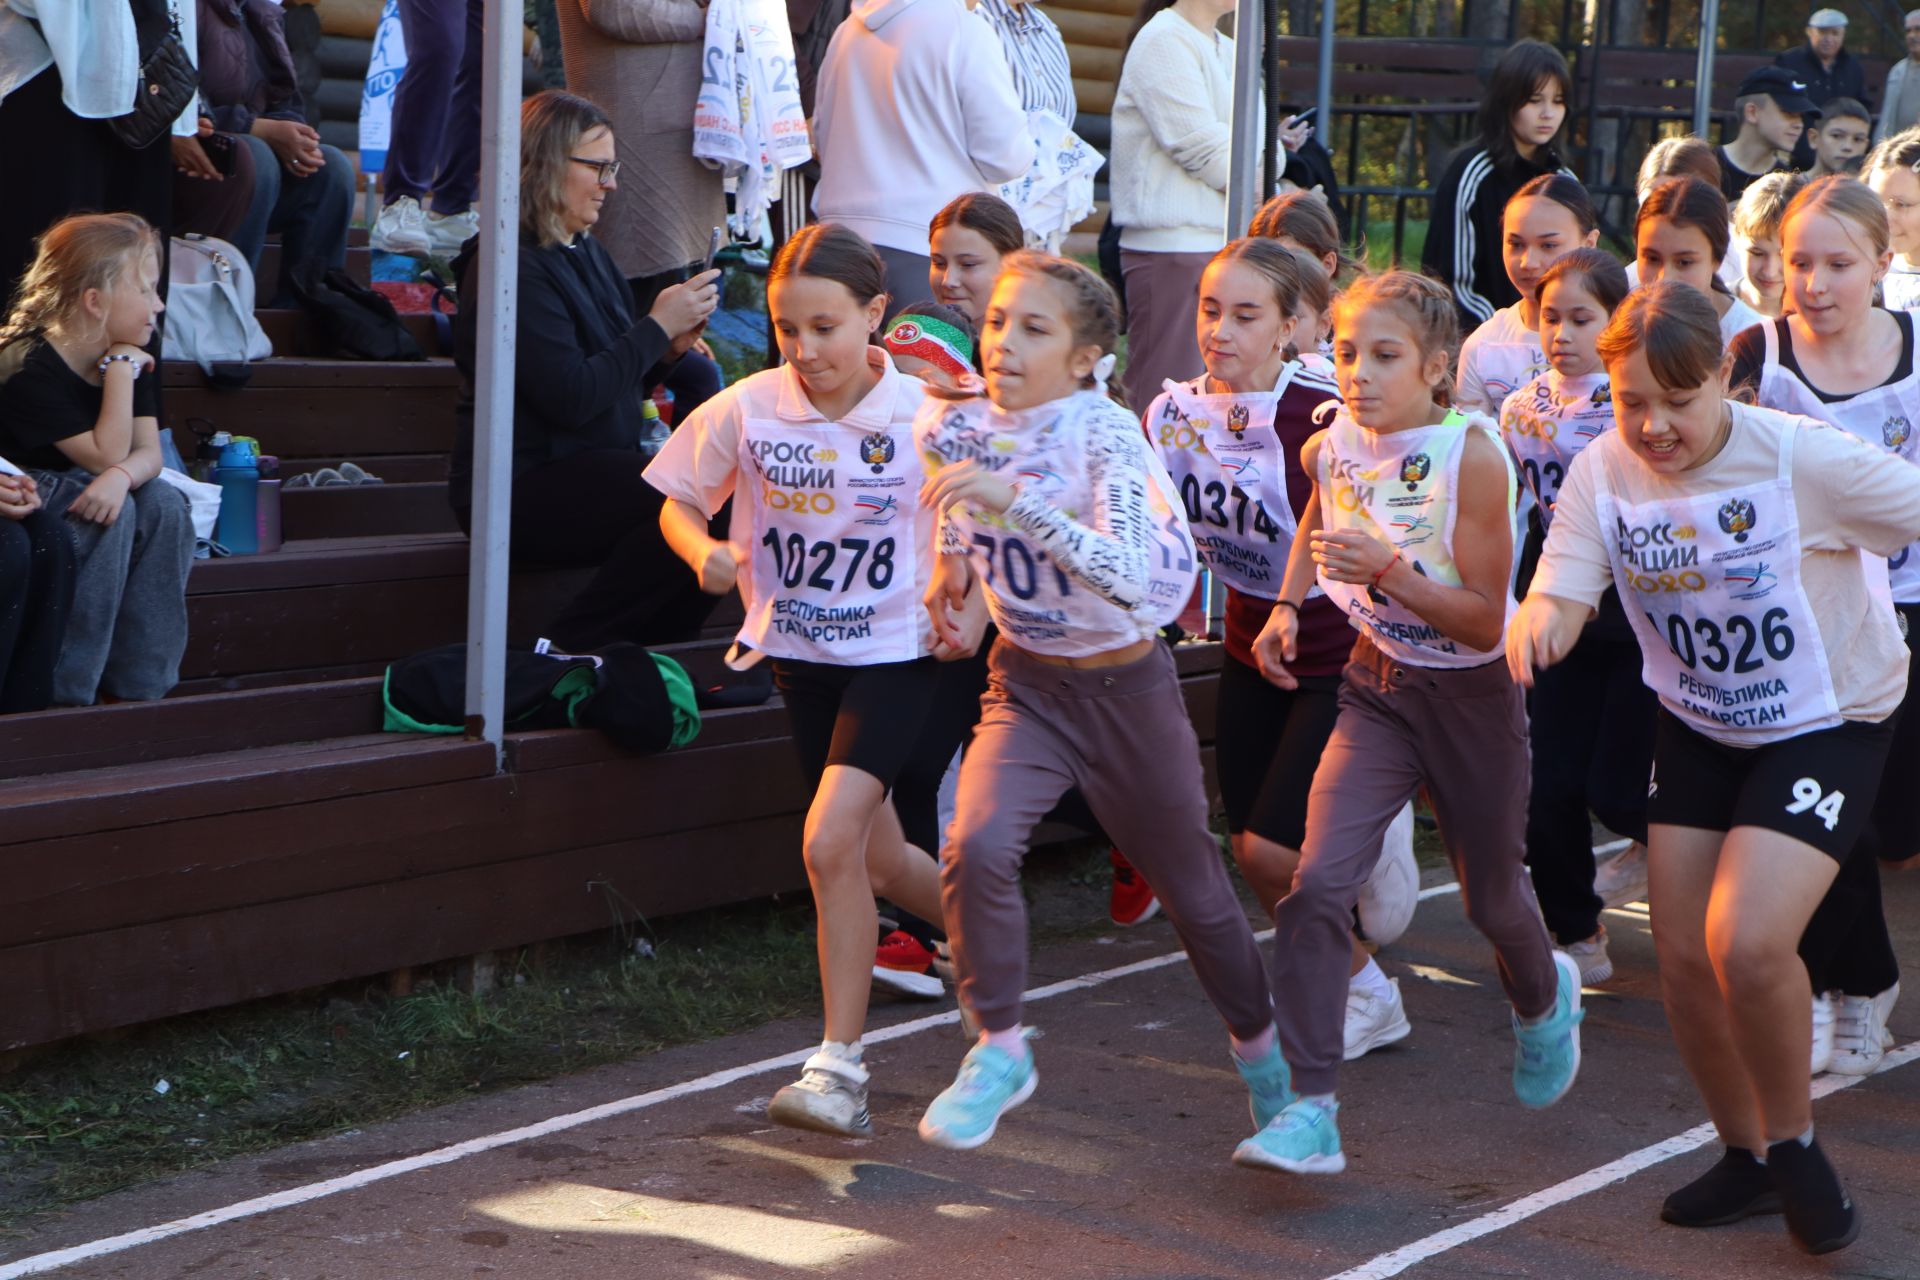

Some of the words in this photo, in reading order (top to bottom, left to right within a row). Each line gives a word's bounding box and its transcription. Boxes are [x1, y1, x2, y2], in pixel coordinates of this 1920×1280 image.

[762, 527, 896, 593] 10278
[772, 599, 876, 622] ЕСПУБЛИКА
[1679, 672, 1789, 707] РЕСПУБЛИКА
[1785, 777, 1846, 831] 94
